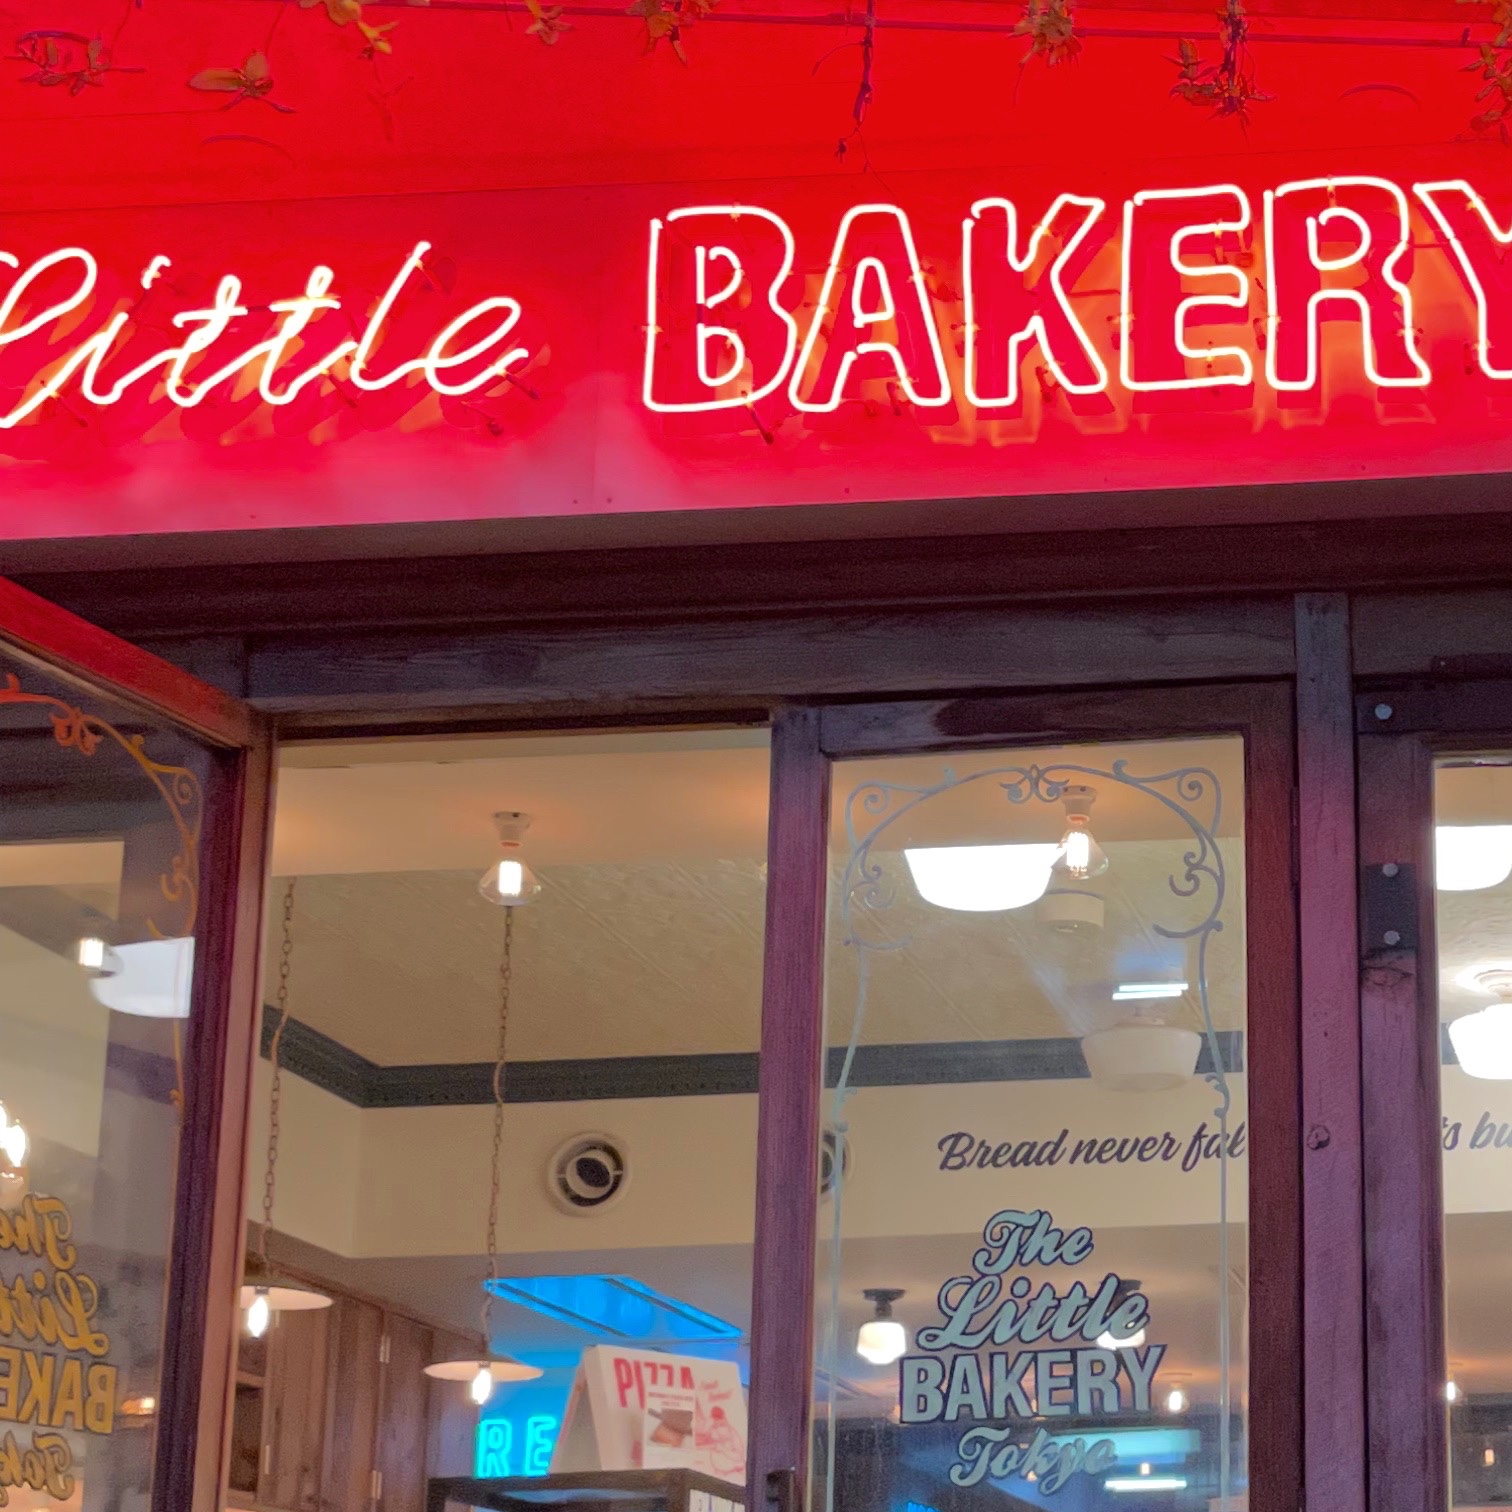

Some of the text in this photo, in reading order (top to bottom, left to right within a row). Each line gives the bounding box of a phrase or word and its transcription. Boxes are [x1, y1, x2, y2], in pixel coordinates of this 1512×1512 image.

[937, 1121, 1246, 1172] Bread never fal
[972, 1209, 1095, 1275] The
[916, 1272, 1150, 1350] Little
[900, 1344, 1168, 1424] BAKERY
[949, 1426, 1118, 1496] Tokyo
